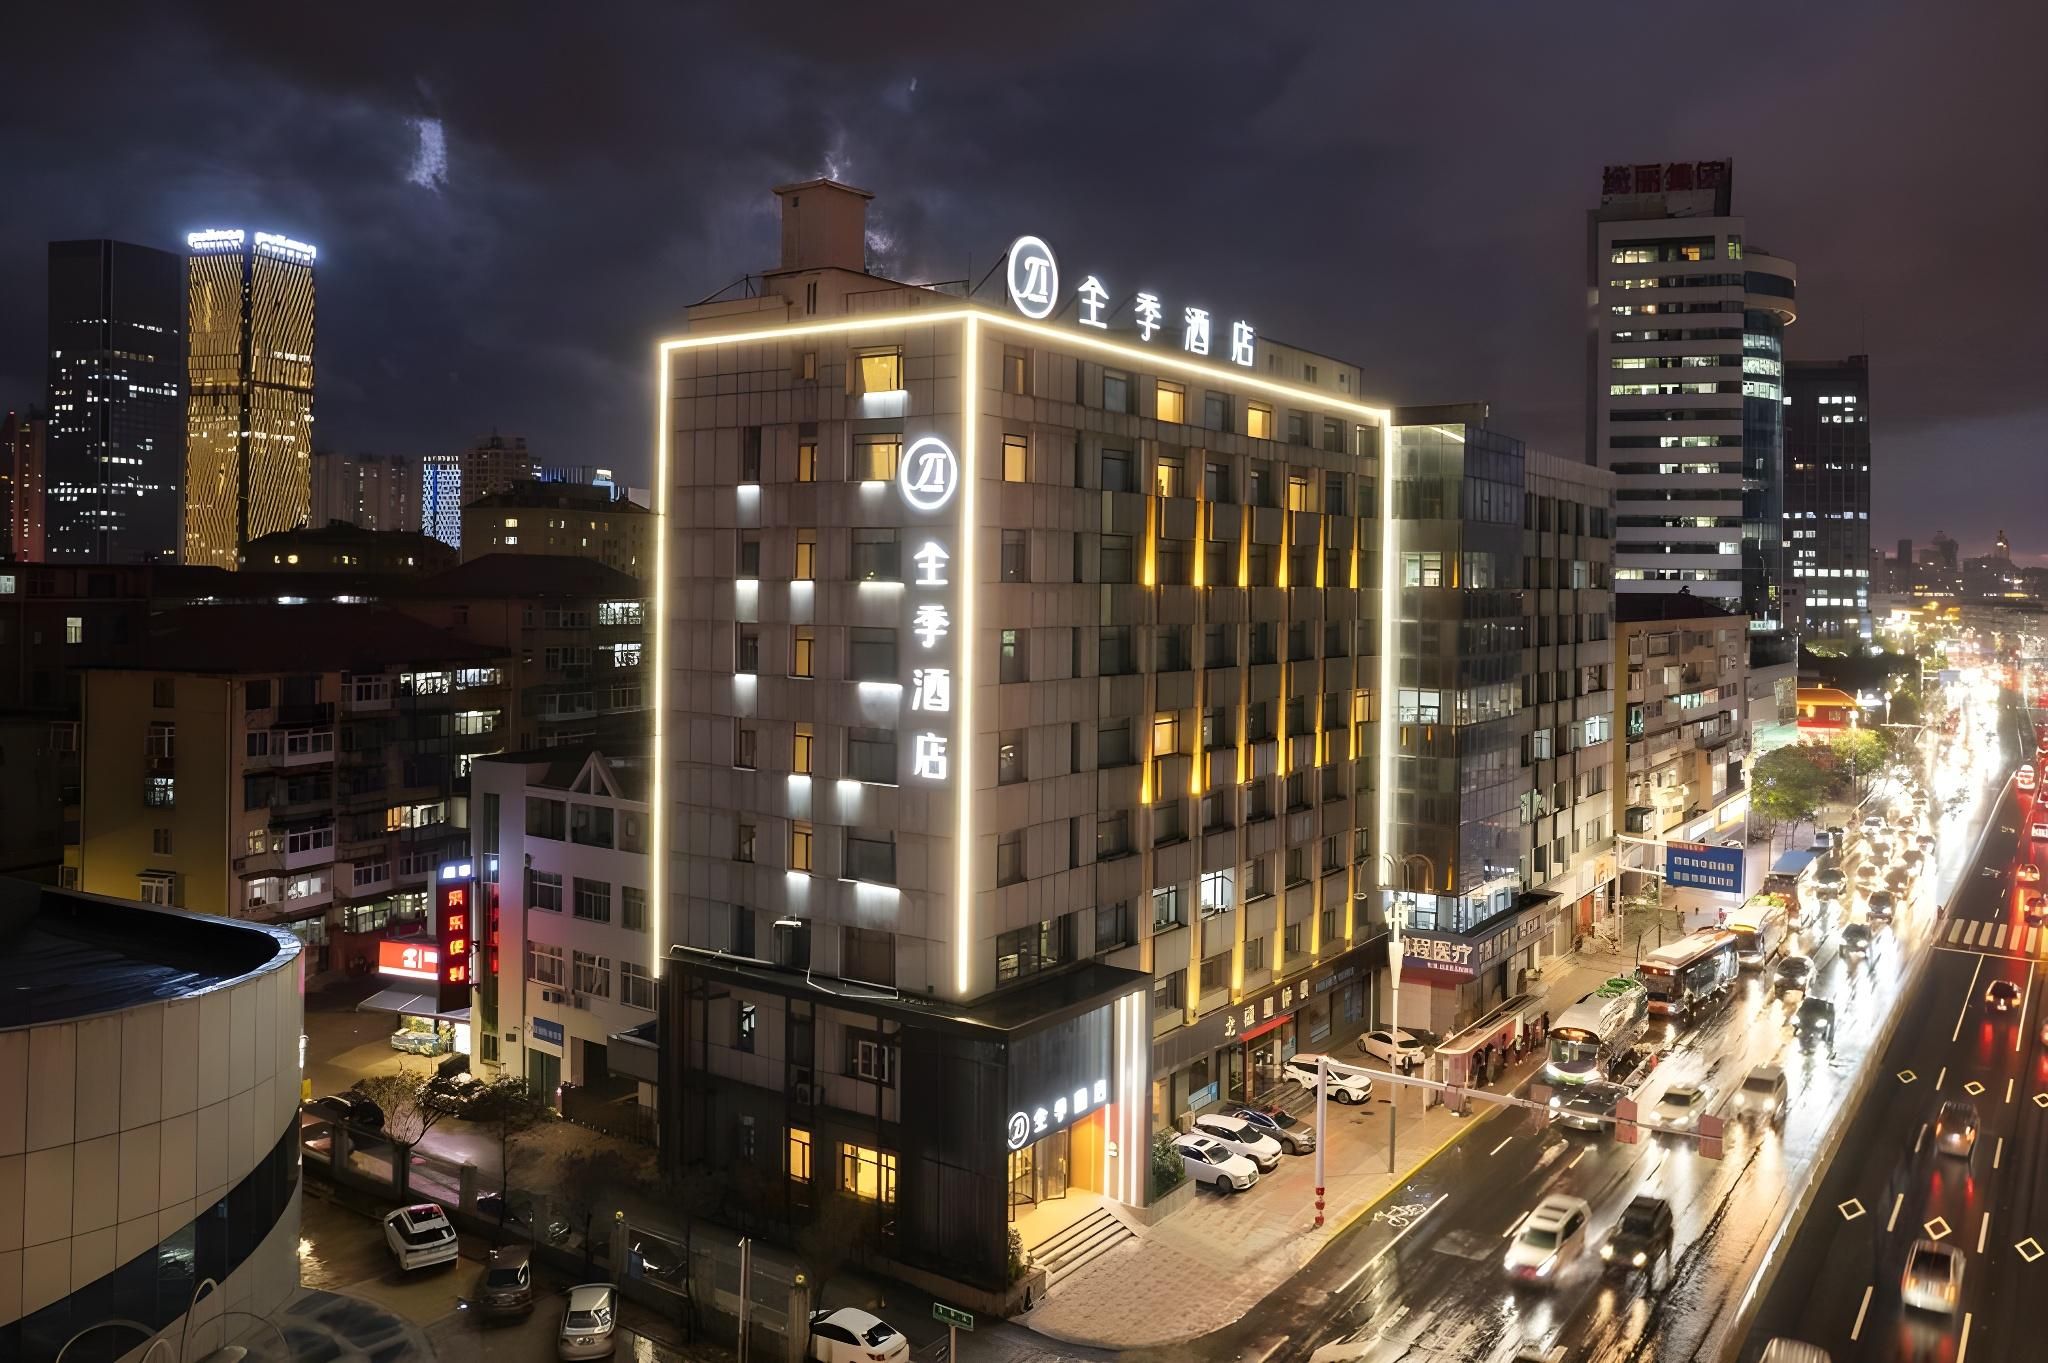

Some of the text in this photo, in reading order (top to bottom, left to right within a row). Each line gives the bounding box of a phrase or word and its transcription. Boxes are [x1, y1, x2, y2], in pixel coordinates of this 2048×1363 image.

[1077, 275, 1254, 367] 全季酒店
[911, 541, 951, 780] 全季酒店
